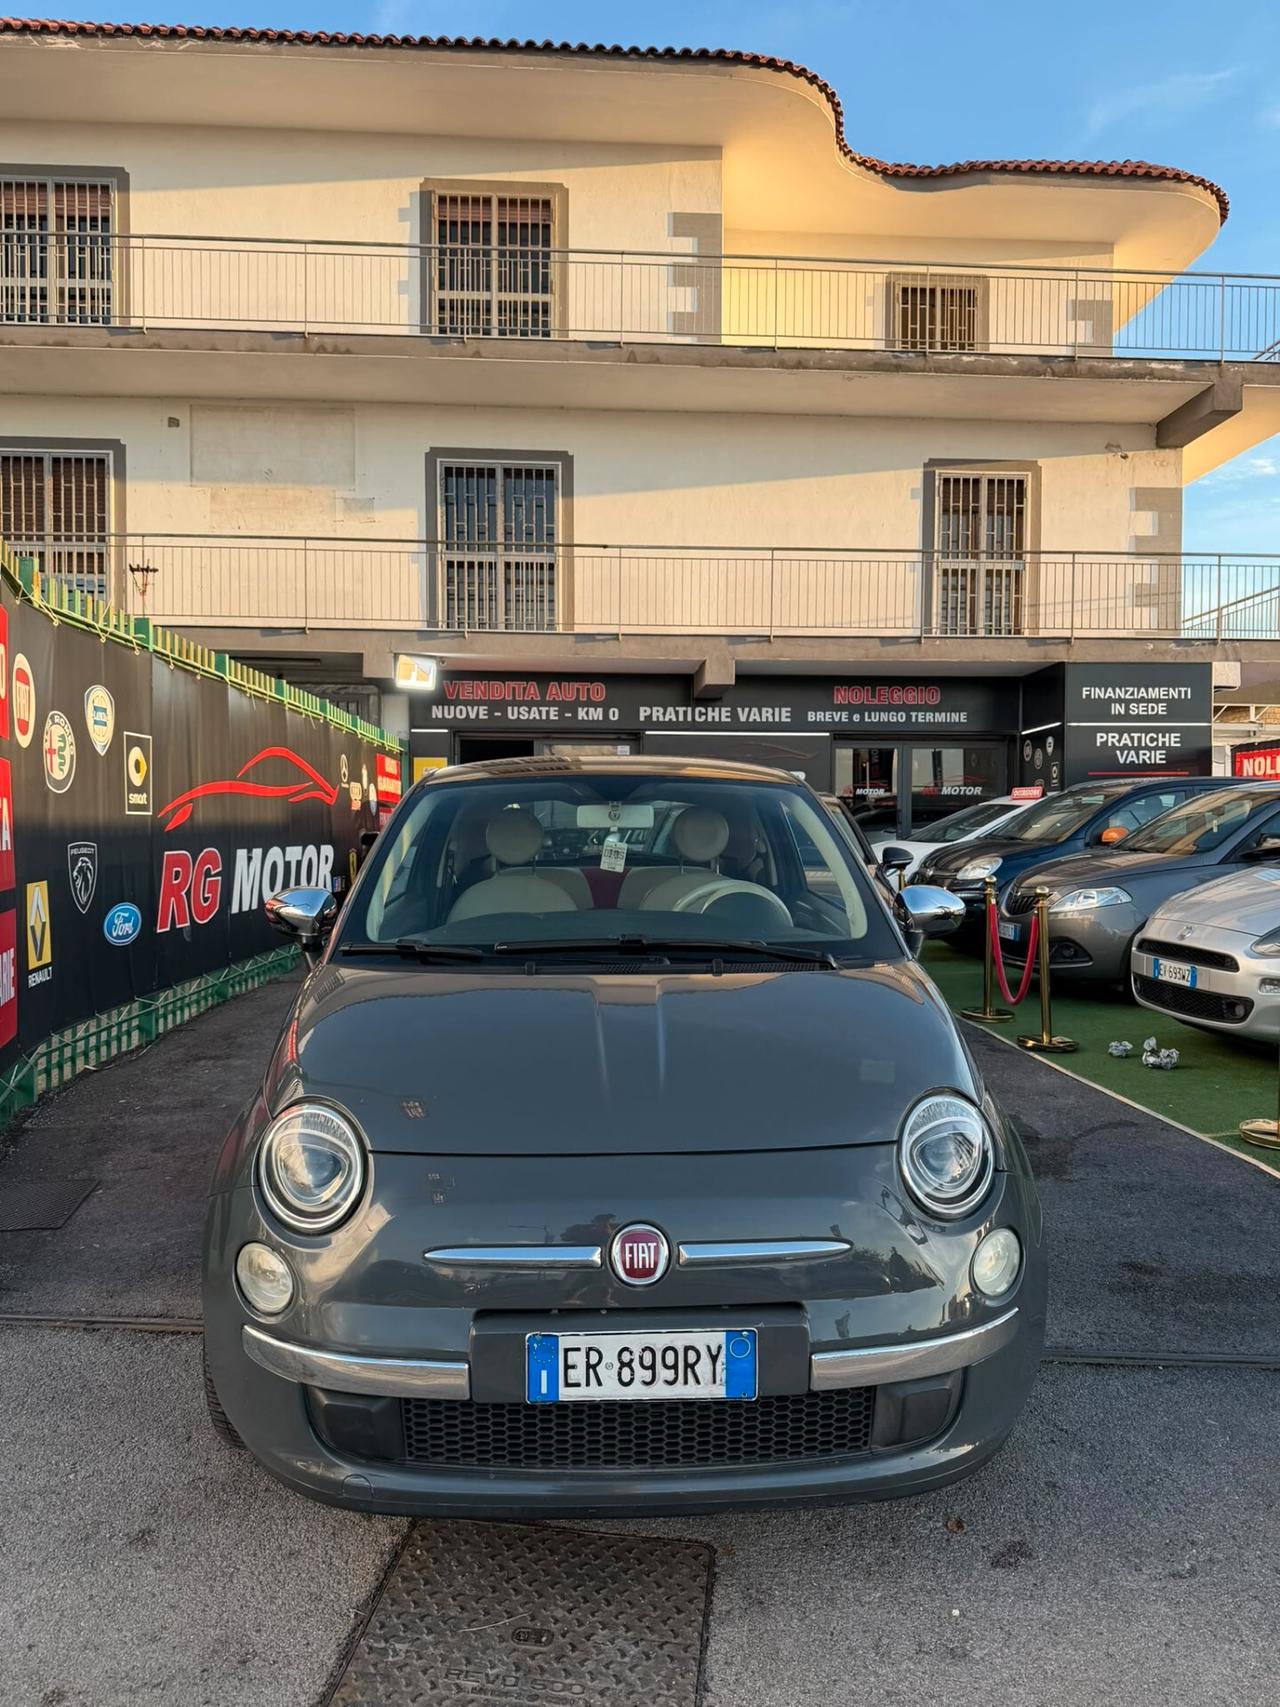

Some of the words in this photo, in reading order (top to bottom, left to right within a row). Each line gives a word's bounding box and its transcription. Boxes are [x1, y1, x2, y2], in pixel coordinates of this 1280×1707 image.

[443, 681, 540, 701] VENDITA
[546, 682, 606, 702] AUTO
[833, 686, 941, 705] NOLEGGIO
[1082, 687, 1191, 699] FINANZIAMENTI
[431, 705, 489, 719] NUOVE
[507, 706, 559, 720] USATE
[577, 707, 603, 721] KM
[639, 706, 731, 722] PRATICHE
[737, 707, 792, 722] VARIE
[807, 711, 849, 722] BREVE
[852, 714, 861, 722] e
[864, 711, 906, 722] LUNGO
[910, 711, 967, 723] TERMINE
[1111, 703, 1125, 715] IN
[1129, 703, 1167, 715] SEDE
[1096, 732, 1181, 747] PRATICHE
[1116, 750, 1167, 764] VARIE
[941, 786, 982, 795] MOTOR
[157, 848, 222, 933] RG
[231, 844, 335, 914] MOTOR
[112, 911, 134, 937] Ford
[28, 966, 52, 989] RENAULT
[625, 1243, 657, 1269] FIAT
[563, 1346, 603, 1388] ER
[617, 1344, 722, 1387] 899RY
